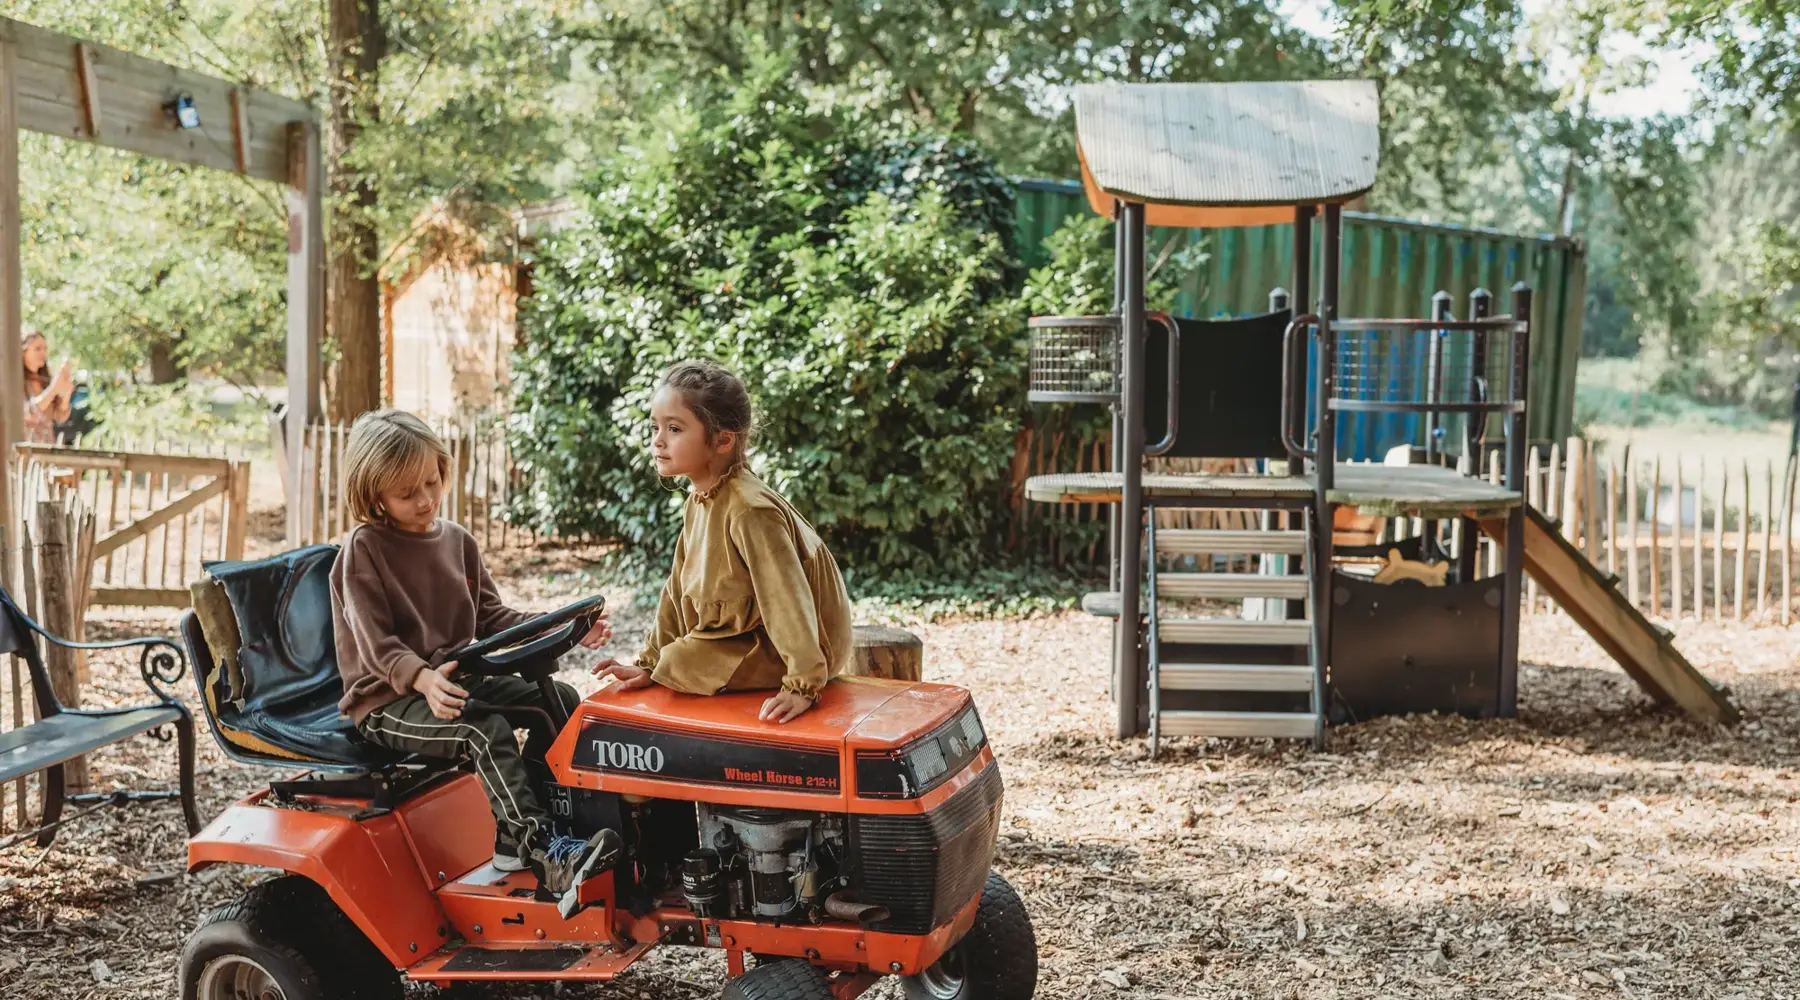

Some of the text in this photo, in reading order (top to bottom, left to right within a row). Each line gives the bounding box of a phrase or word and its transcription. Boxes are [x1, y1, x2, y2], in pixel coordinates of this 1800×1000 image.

[592, 739, 665, 773] TORO
[724, 767, 837, 788] Wheel Horse 212-H
